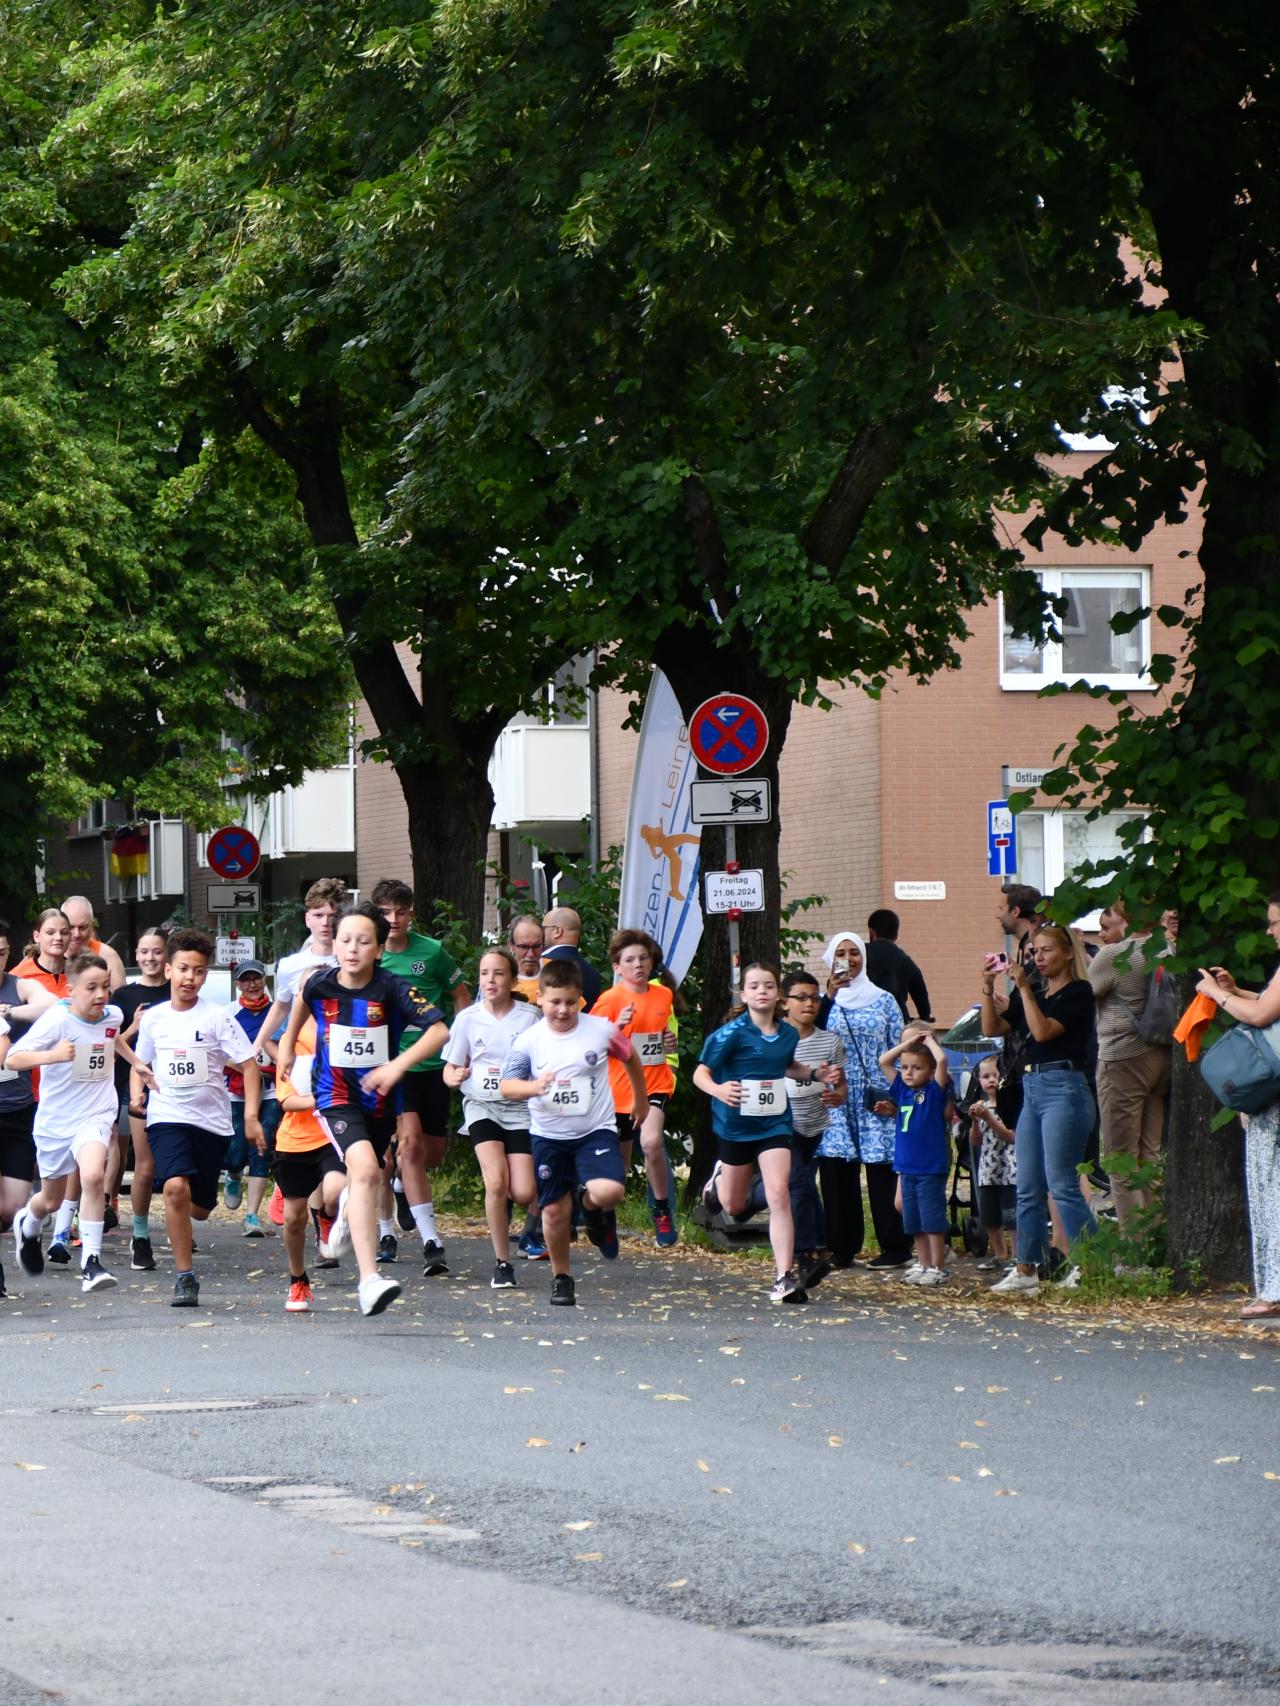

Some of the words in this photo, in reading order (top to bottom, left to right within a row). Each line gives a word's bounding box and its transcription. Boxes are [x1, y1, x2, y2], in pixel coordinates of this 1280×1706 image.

[720, 877, 749, 885] Freitag
[713, 888, 757, 897] 21.06.2024
[715, 900, 737, 909] 15-21
[740, 900, 756, 908] Uhr
[344, 1042, 375, 1056] 454
[89, 1055, 105, 1070] 59
[169, 1061, 195, 1076] 368
[483, 1078, 502, 1090] 25
[552, 1091, 579, 1105] 465
[758, 1092, 774, 1105] 90
[900, 1106, 914, 1133] 7
